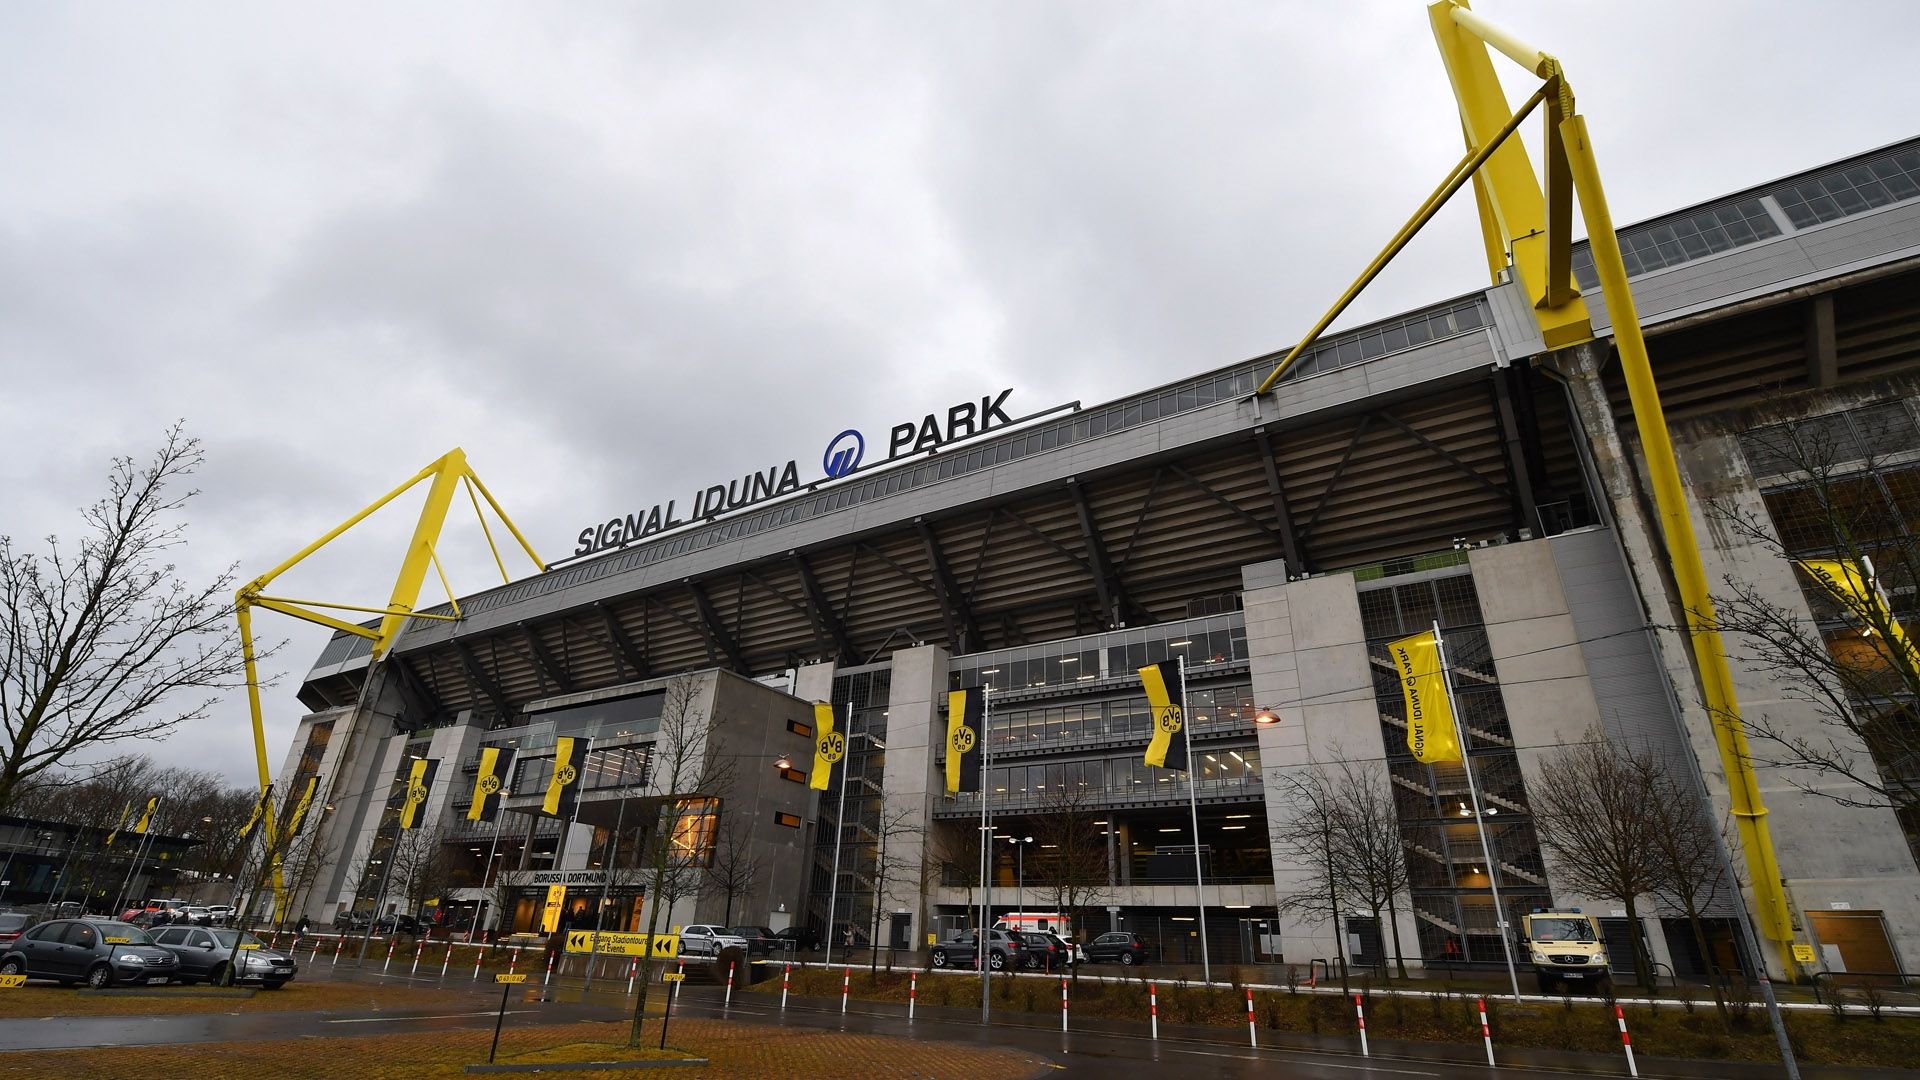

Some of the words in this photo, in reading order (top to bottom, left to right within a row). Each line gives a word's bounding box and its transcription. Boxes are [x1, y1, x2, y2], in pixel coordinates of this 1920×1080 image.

[575, 500, 681, 555] SIGNAL
[692, 460, 800, 521] IDUNA
[889, 388, 1013, 458] PARK
[568, 872, 607, 883] DORTMUND
[590, 933, 611, 945] Egang
[612, 935, 649, 946] Stadiontoure
[607, 945, 625, 953] Events
